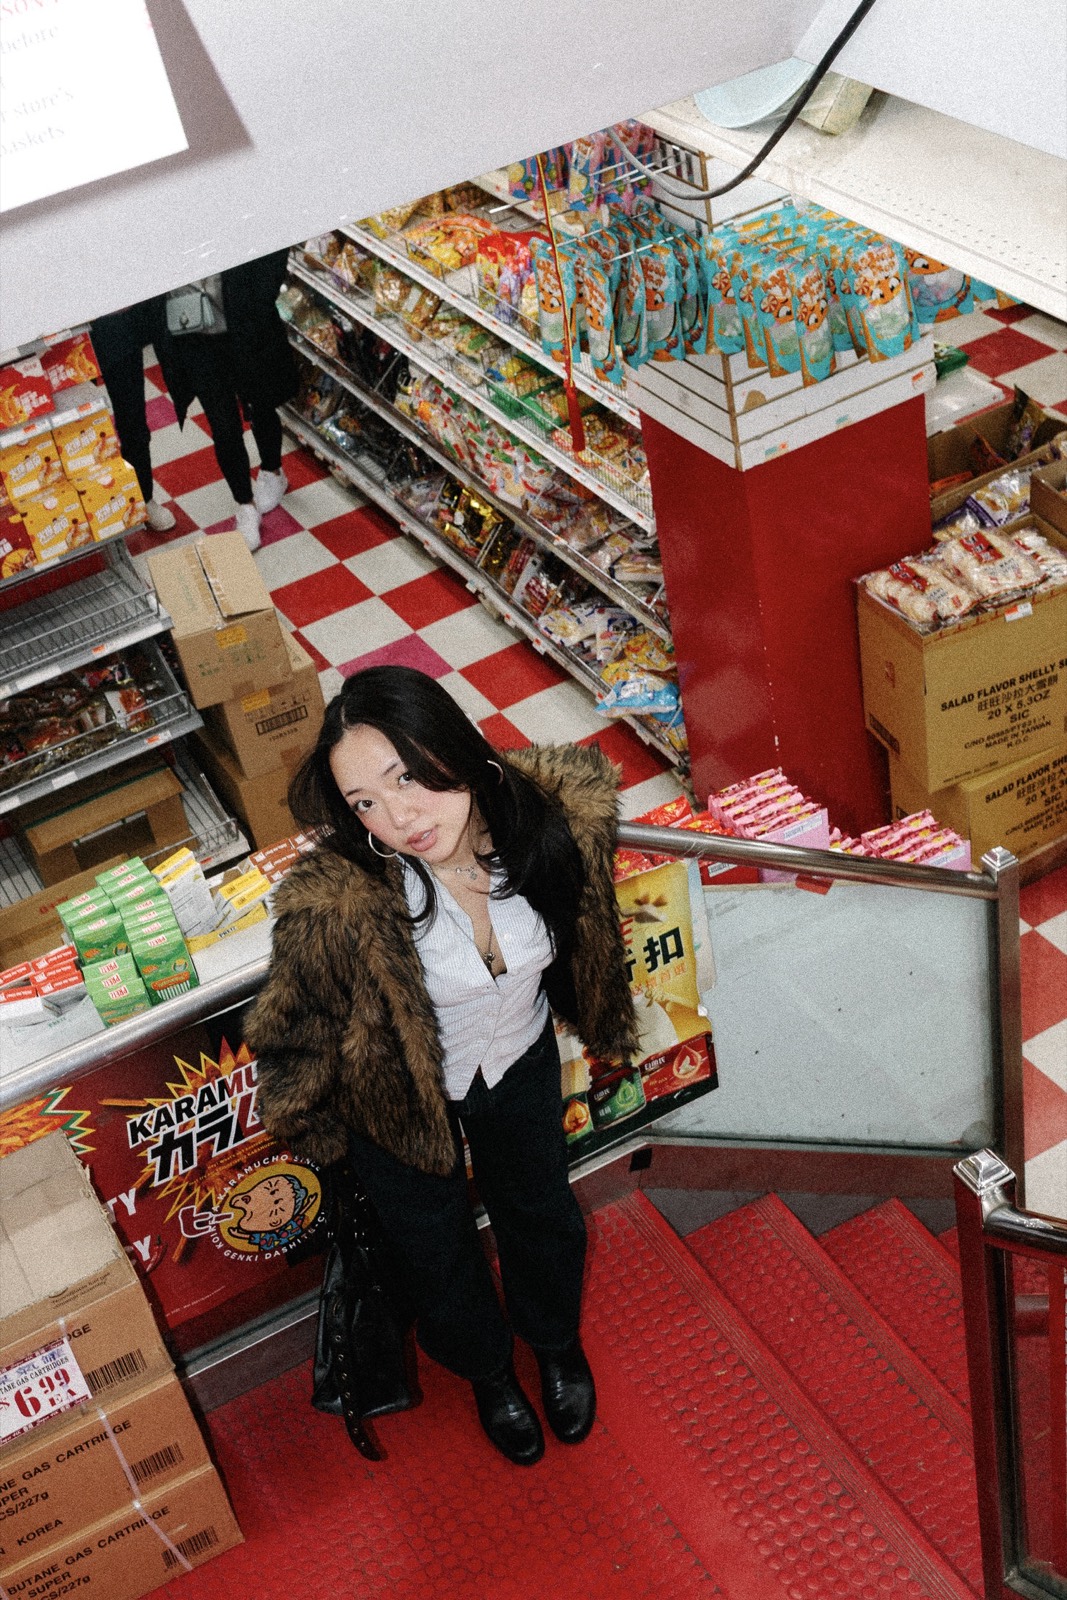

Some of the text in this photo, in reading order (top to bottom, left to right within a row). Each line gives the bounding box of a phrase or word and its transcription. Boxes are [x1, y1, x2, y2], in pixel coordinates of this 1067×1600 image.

[940, 692, 975, 712] SALAD
[977, 678, 1017, 700] FLAVOR
[1019, 663, 1056, 688] SHELLY
[987, 706, 1001, 722] 20
[985, 782, 1015, 803] SALAD
[1016, 765, 1050, 790] FLAVOR
[217, 1153, 289, 1201] KARAMUCHO
[223, 1248, 260, 1262] GENKI
[17, 1375, 30, 1388] GAS
[30, 1356, 70, 1379] CARTRIDGES
[21, 1461, 51, 1481] GAS
[16, 1519, 63, 1547] KOREA
[7, 1563, 61, 1596] BUTANE
[65, 1546, 94, 1566] GAS
[28, 1571, 72, 1599] SUPER
